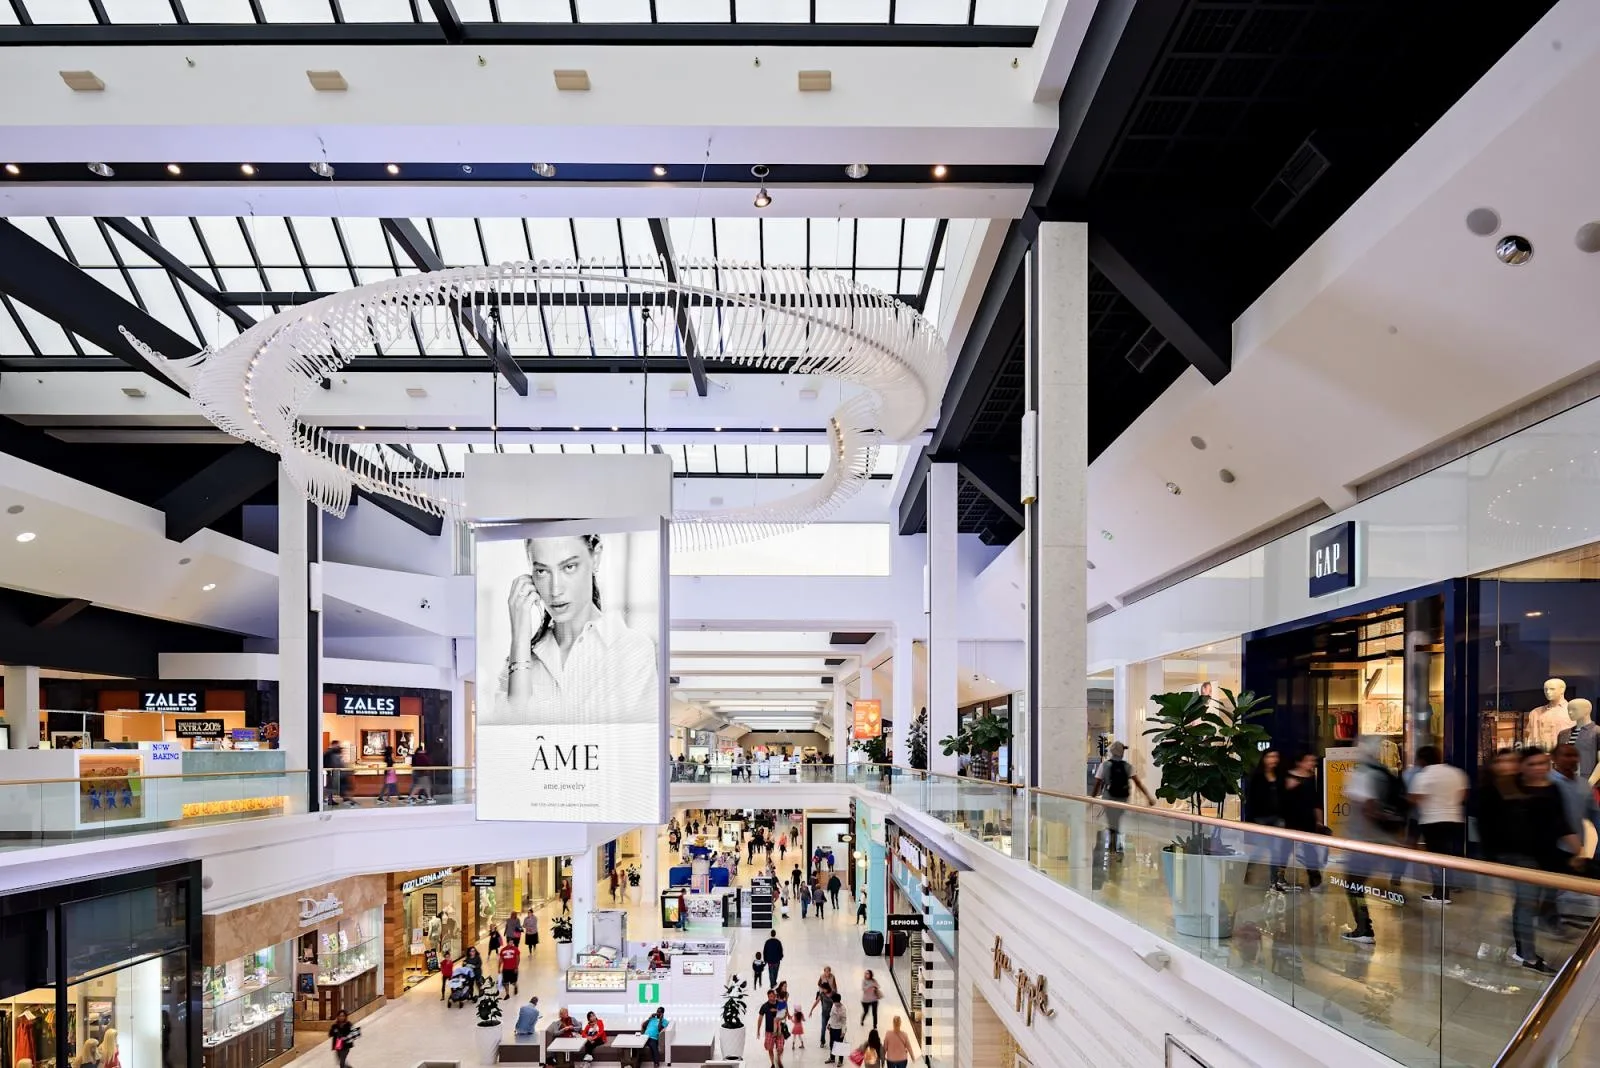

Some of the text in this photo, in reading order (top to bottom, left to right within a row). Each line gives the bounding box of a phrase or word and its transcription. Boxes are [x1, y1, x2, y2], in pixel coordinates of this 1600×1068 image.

[1315, 543, 1340, 578] GAP
[145, 693, 197, 707] ZALES
[344, 697, 395, 711] ZALES
[531, 735, 599, 771] ÂME
